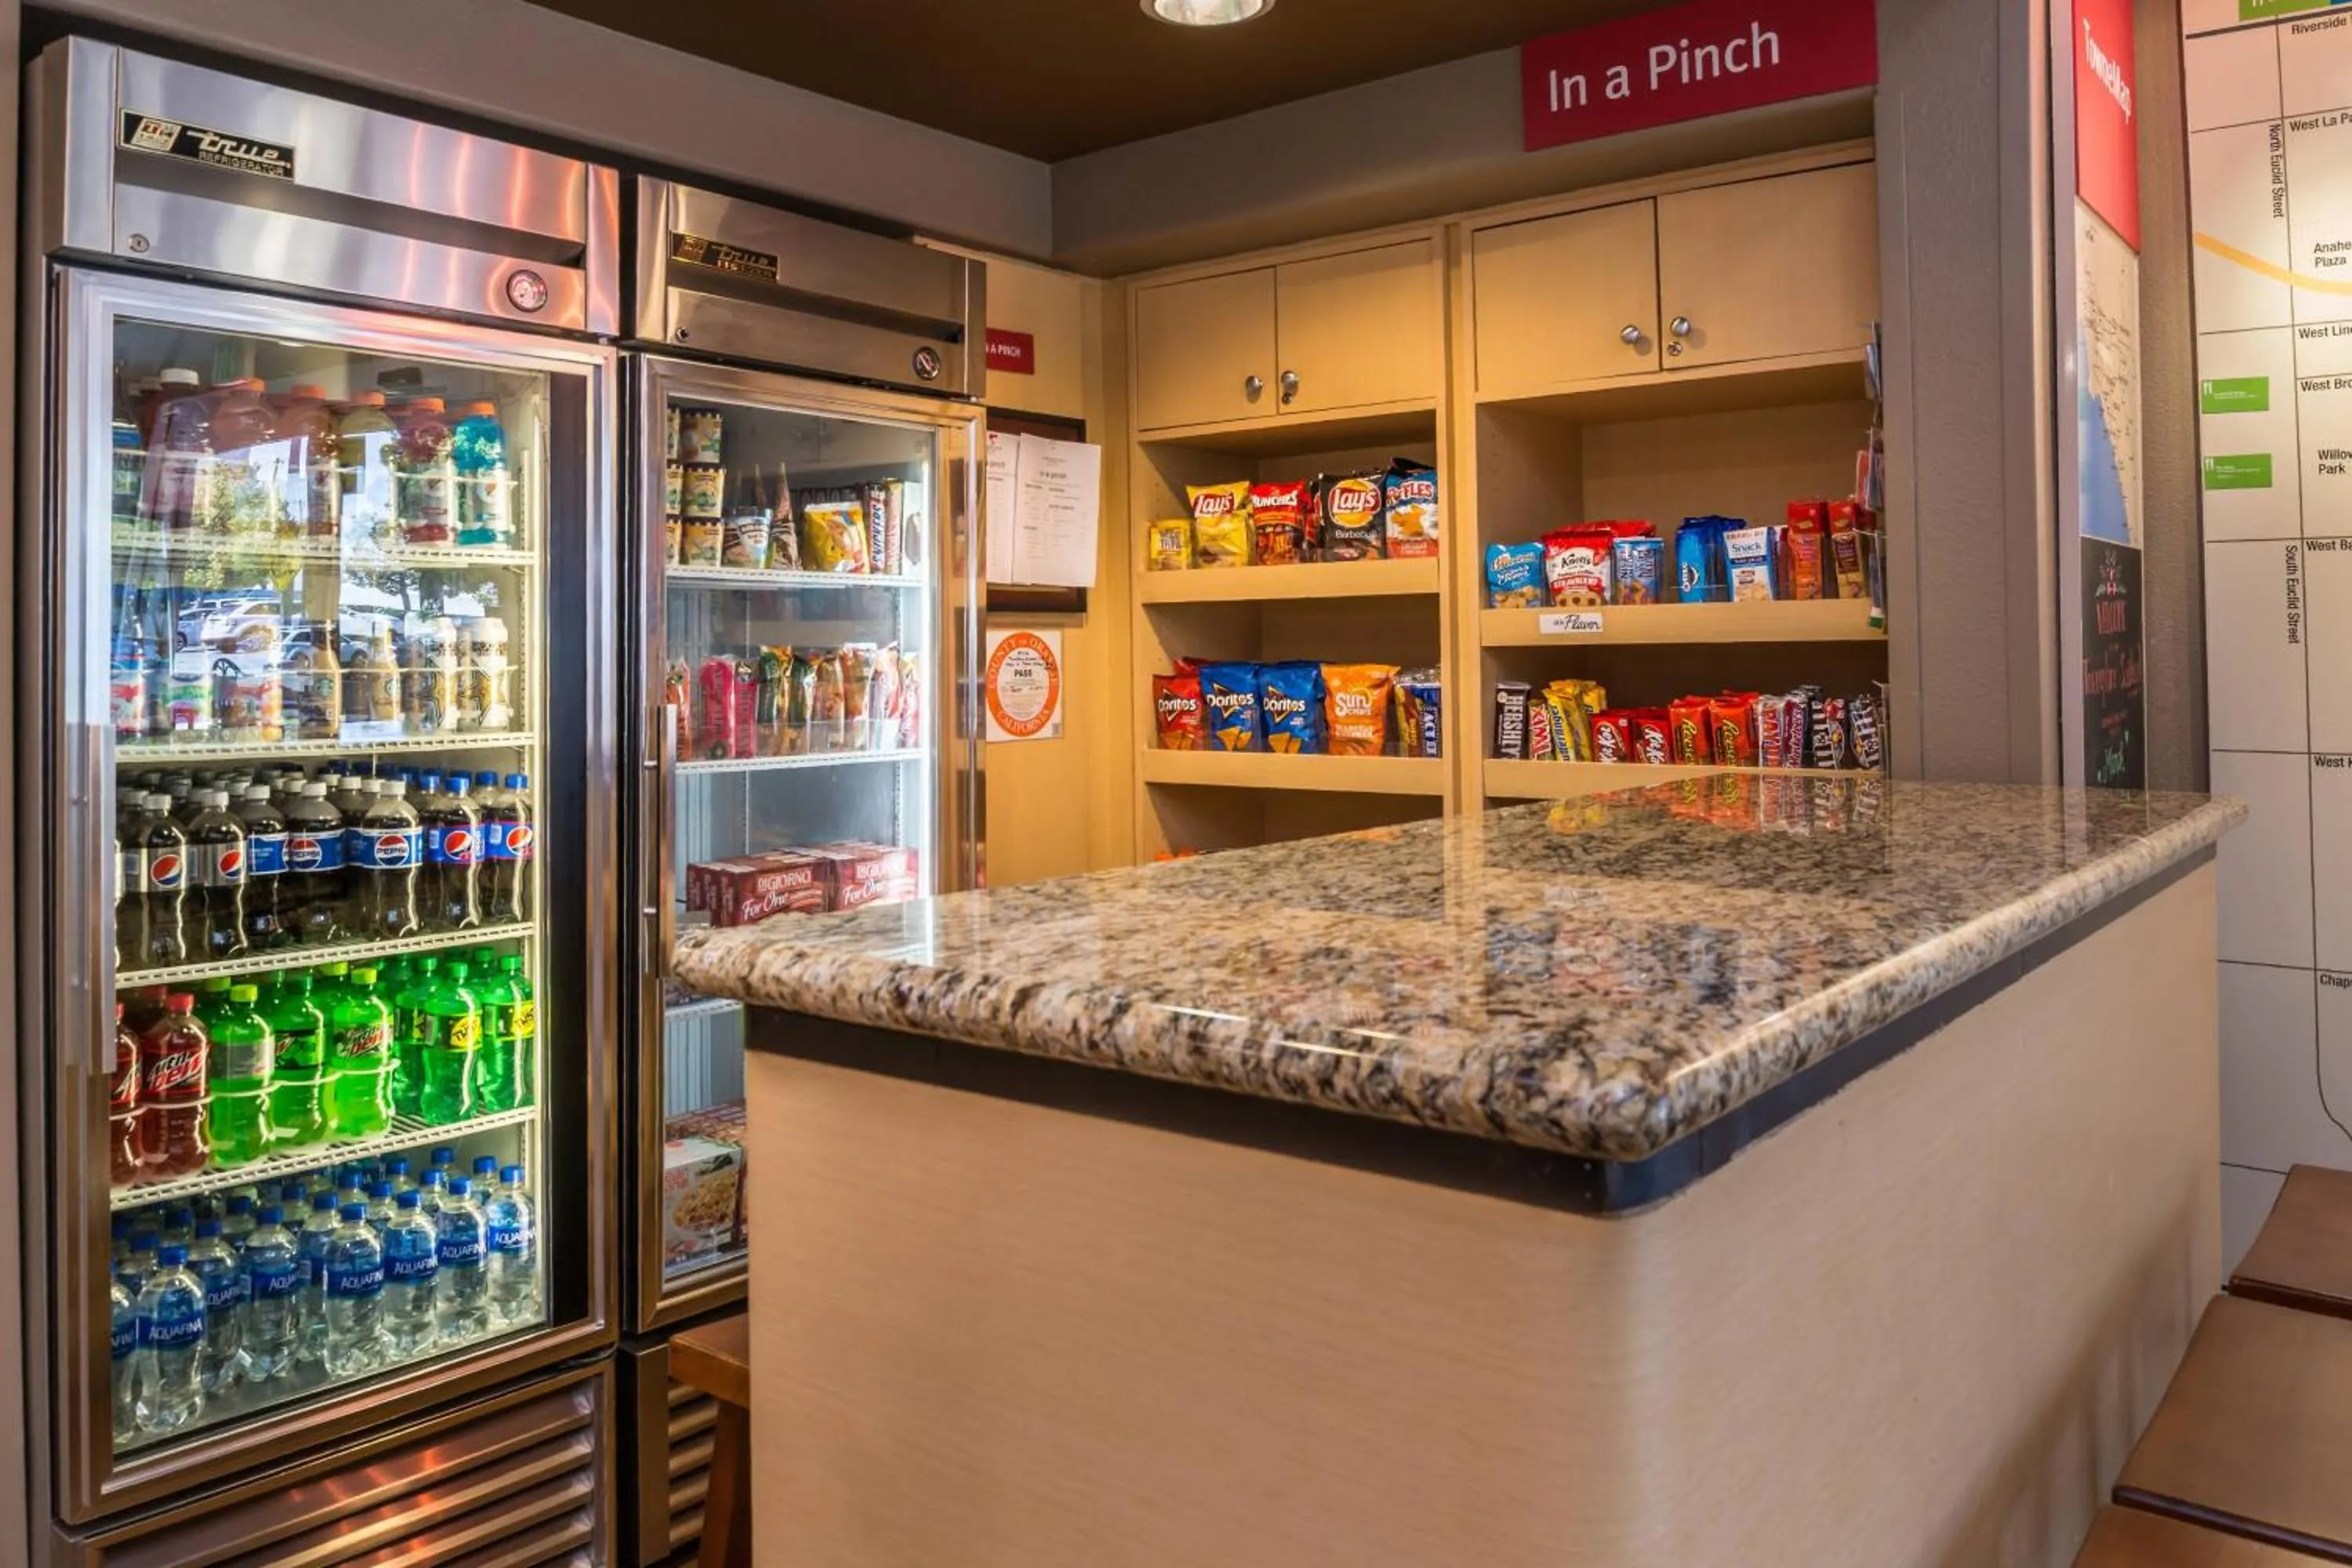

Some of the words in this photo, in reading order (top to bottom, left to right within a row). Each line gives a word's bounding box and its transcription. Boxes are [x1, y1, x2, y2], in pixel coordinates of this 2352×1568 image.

[2292, 16, 2347, 34] Riverside
[1549, 69, 1587, 112] In
[1606, 65, 1630, 100] a
[1649, 20, 1780, 91] Pinch
[2289, 118, 2319, 132] West
[2323, 115, 2337, 127] La
[2269, 123, 2282, 152] North
[198, 150, 284, 176] REFRIGERATOR
[2270, 155, 2284, 185] Euclid
[2272, 187, 2285, 219] Street
[2314, 256, 2347, 268] Plaza
[2298, 327, 2328, 339] West
[2300, 380, 2330, 392] West
[2318, 463, 2347, 475] Park
[2306, 540, 2337, 552] West
[2285, 544, 2299, 575] South
[2286, 578, 2300, 610] Euclid
[2287, 612, 2300, 644] Street
[1158, 698, 1196, 711] Doritos
[1206, 692, 1255, 707] Doritos
[1263, 697, 1306, 712] Doritos
[1551, 706, 1570, 761] utterfinger
[2314, 755, 2345, 768] West
[340, 1267, 385, 1290] AQUAFIN
[147, 1317, 204, 1341] AQUAFINA
